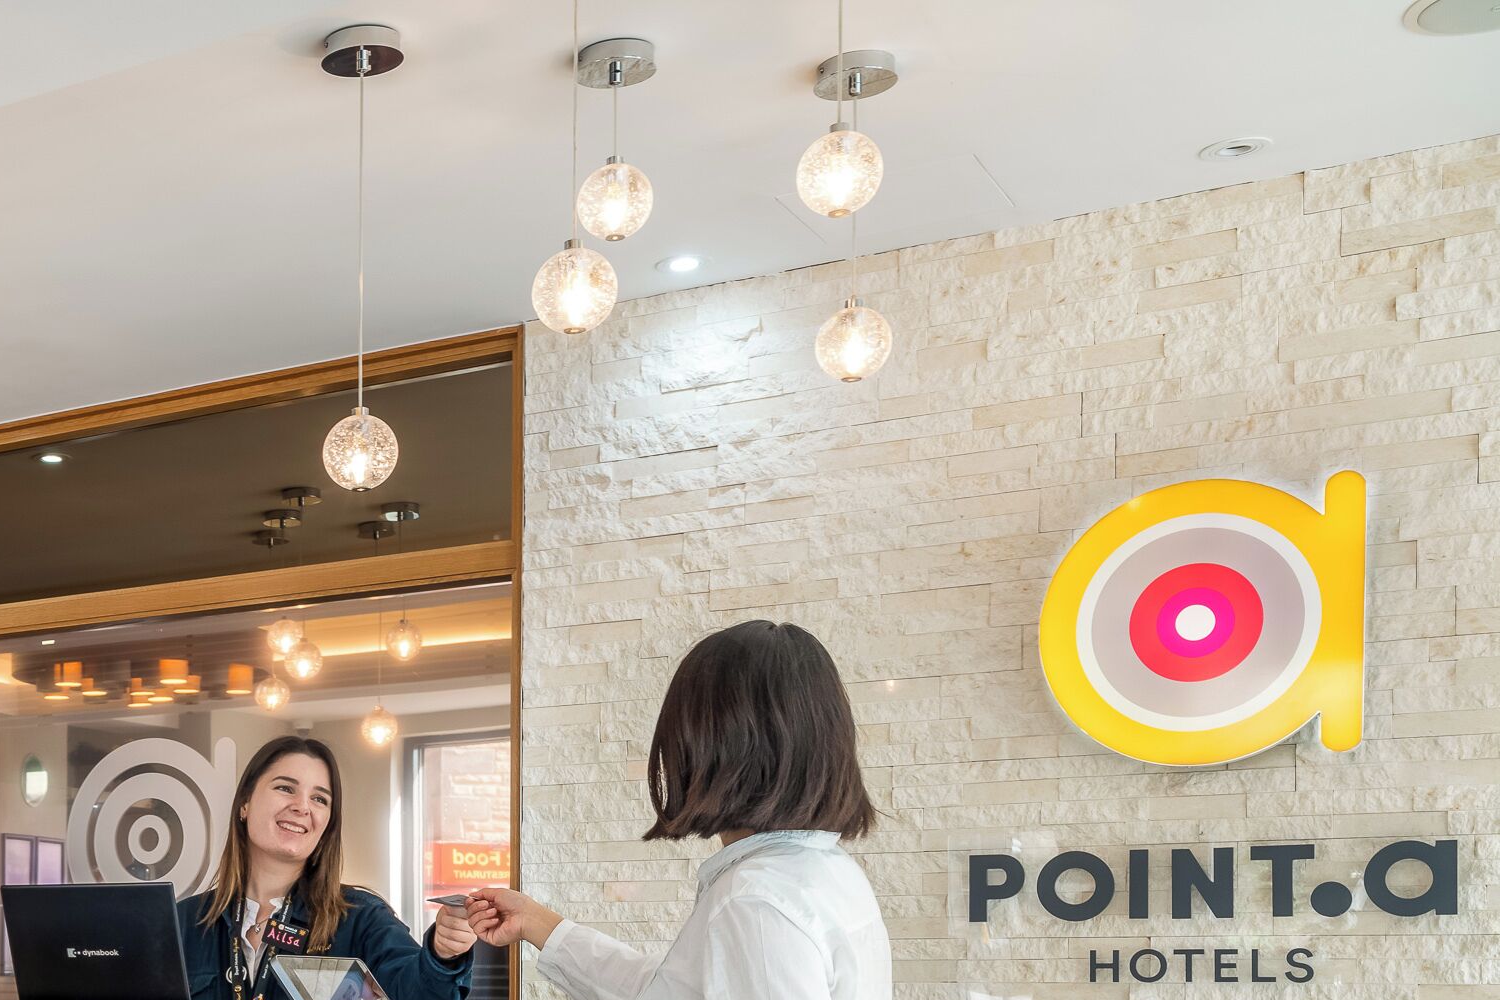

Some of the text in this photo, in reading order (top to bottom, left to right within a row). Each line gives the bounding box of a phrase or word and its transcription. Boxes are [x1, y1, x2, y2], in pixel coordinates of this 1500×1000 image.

[267, 927, 300, 947] Ailsa
[82, 949, 120, 957] dynabook
[1089, 947, 1315, 983] HOTELS
